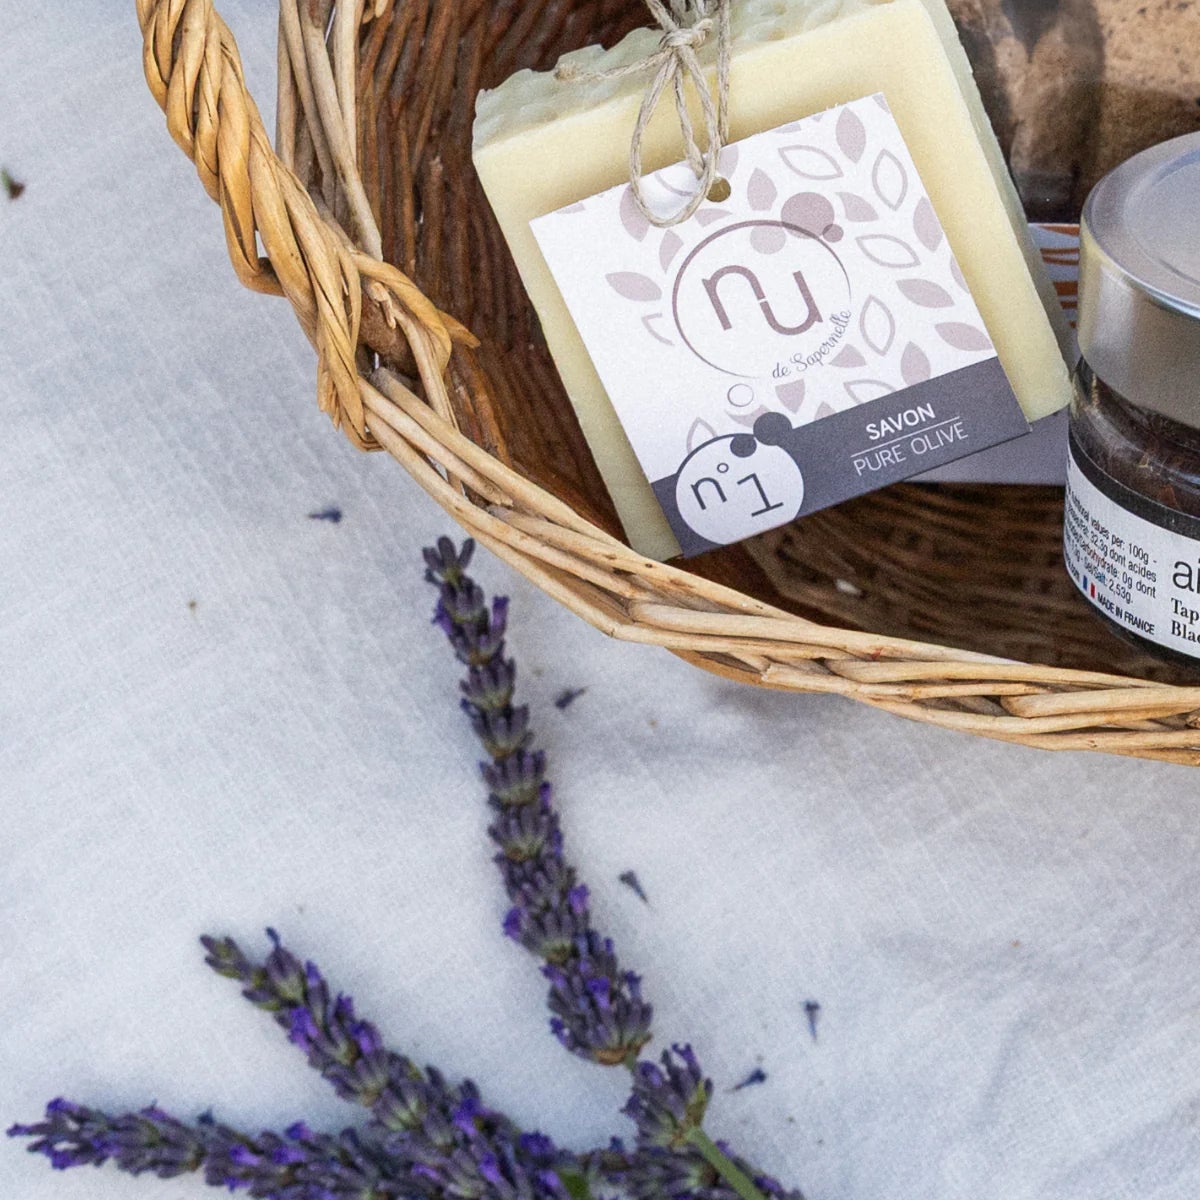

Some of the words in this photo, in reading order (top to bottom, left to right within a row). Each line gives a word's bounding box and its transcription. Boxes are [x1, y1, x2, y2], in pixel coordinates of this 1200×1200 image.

[701, 265, 823, 336] nu
[772, 362, 791, 379] de
[866, 402, 936, 441] SAVON
[853, 444, 907, 477] PURE
[910, 421, 968, 455] OLIVE
[1109, 549, 1126, 566] dont
[1128, 559, 1157, 582] acides
[1128, 543, 1149, 565] 100g
[1136, 579, 1156, 598] dont
[1097, 591, 1115, 615] MADE
[1115, 606, 1123, 619] IN
[1124, 612, 1155, 635] FRANCE
